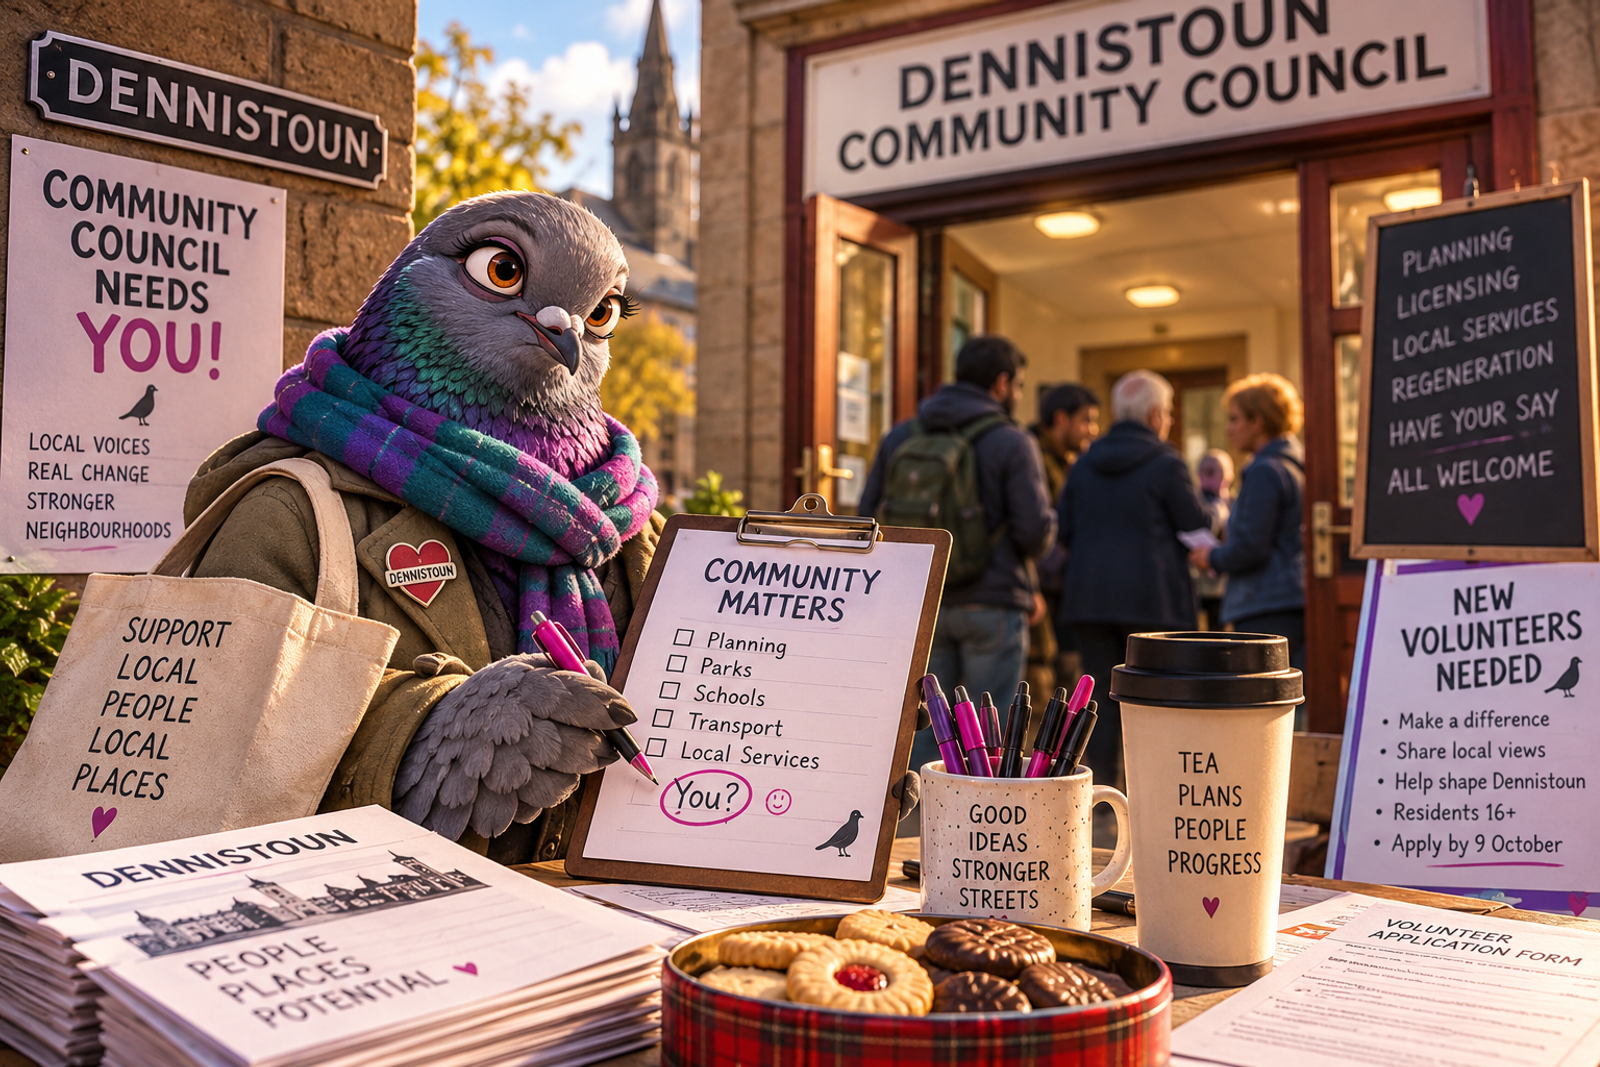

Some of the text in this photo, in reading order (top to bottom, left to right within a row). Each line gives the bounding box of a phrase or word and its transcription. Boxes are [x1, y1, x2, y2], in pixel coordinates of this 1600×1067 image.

[899, 0, 1330, 111] DENNISTOUN
[68, 58, 368, 168] DENNISTOUN
[838, 34, 1447, 172] COMMUNITY COUNCIL
[43, 169, 258, 240] COMMUNITY
[71, 220, 230, 276] COUNCIL
[1402, 226, 1514, 277] PLANNING
[95, 269, 209, 314] NEEDS
[1397, 265, 1520, 320] LICENSING
[76, 311, 222, 381] YOU!
[1392, 298, 1559, 362] LOCAL SERVICES
[1392, 340, 1554, 403] REGENERATION
[1389, 388, 1560, 447] HAVE YOUR SAY
[29, 432, 150, 456] LOCAL VOICES
[28, 461, 149, 484] REAL CHANGE
[1387, 450, 1555, 495] ALL WELCOME
[26, 491, 115, 512] STRONGER
[25, 521, 172, 542] NEIGHBOURHOODS
[389, 564, 455, 585] DENNISTOUN
[704, 557, 882, 595] COMMUNITY
[717, 589, 846, 623] MATTERS
[1453, 581, 1515, 616] NEW
[122, 616, 232, 648] SUPPORT
[707, 631, 788, 660] Planning
[1401, 610, 1583, 657] VOLUNTEERS
[117, 653, 198, 685] LOCAL
[700, 657, 753, 679] Parks
[1436, 653, 1542, 692] NEEDED
[101, 690, 198, 724] PEOPLE
[693, 684, 766, 708] Schools
[688, 711, 784, 741] Transport
[1398, 709, 1550, 730] Make a difference
[88, 727, 170, 761] LOCAL
[680, 740, 820, 770] Local Services
[1396, 740, 1546, 760] Share local views
[1178, 751, 1220, 775] TEA
[72, 763, 169, 801] PLACES
[673, 777, 740, 813] You?
[1178, 784, 1243, 808] PLANS
[1395, 771, 1587, 796] Help shape Dennistoun
[969, 804, 1028, 826] GOOD
[1174, 816, 1247, 841] PEOPLE
[1393, 803, 1517, 821] Residents 16+
[82, 828, 359, 889] DENNISTOUN
[968, 832, 1029, 853] IDEAS
[1391, 833, 1564, 858] Apply by 9 October
[951, 857, 1051, 882] STRONGER
[1168, 849, 1262, 875] PROGRESS
[958, 887, 1039, 910] STREETS
[1368, 929, 1583, 967] APPLICATION FORM
[1387, 918, 1513, 944] VOLUNTEER
[187, 934, 339, 982] PEOPLE
[217, 955, 372, 1005] PLACES
[250, 969, 449, 1029] POTENTIAL
